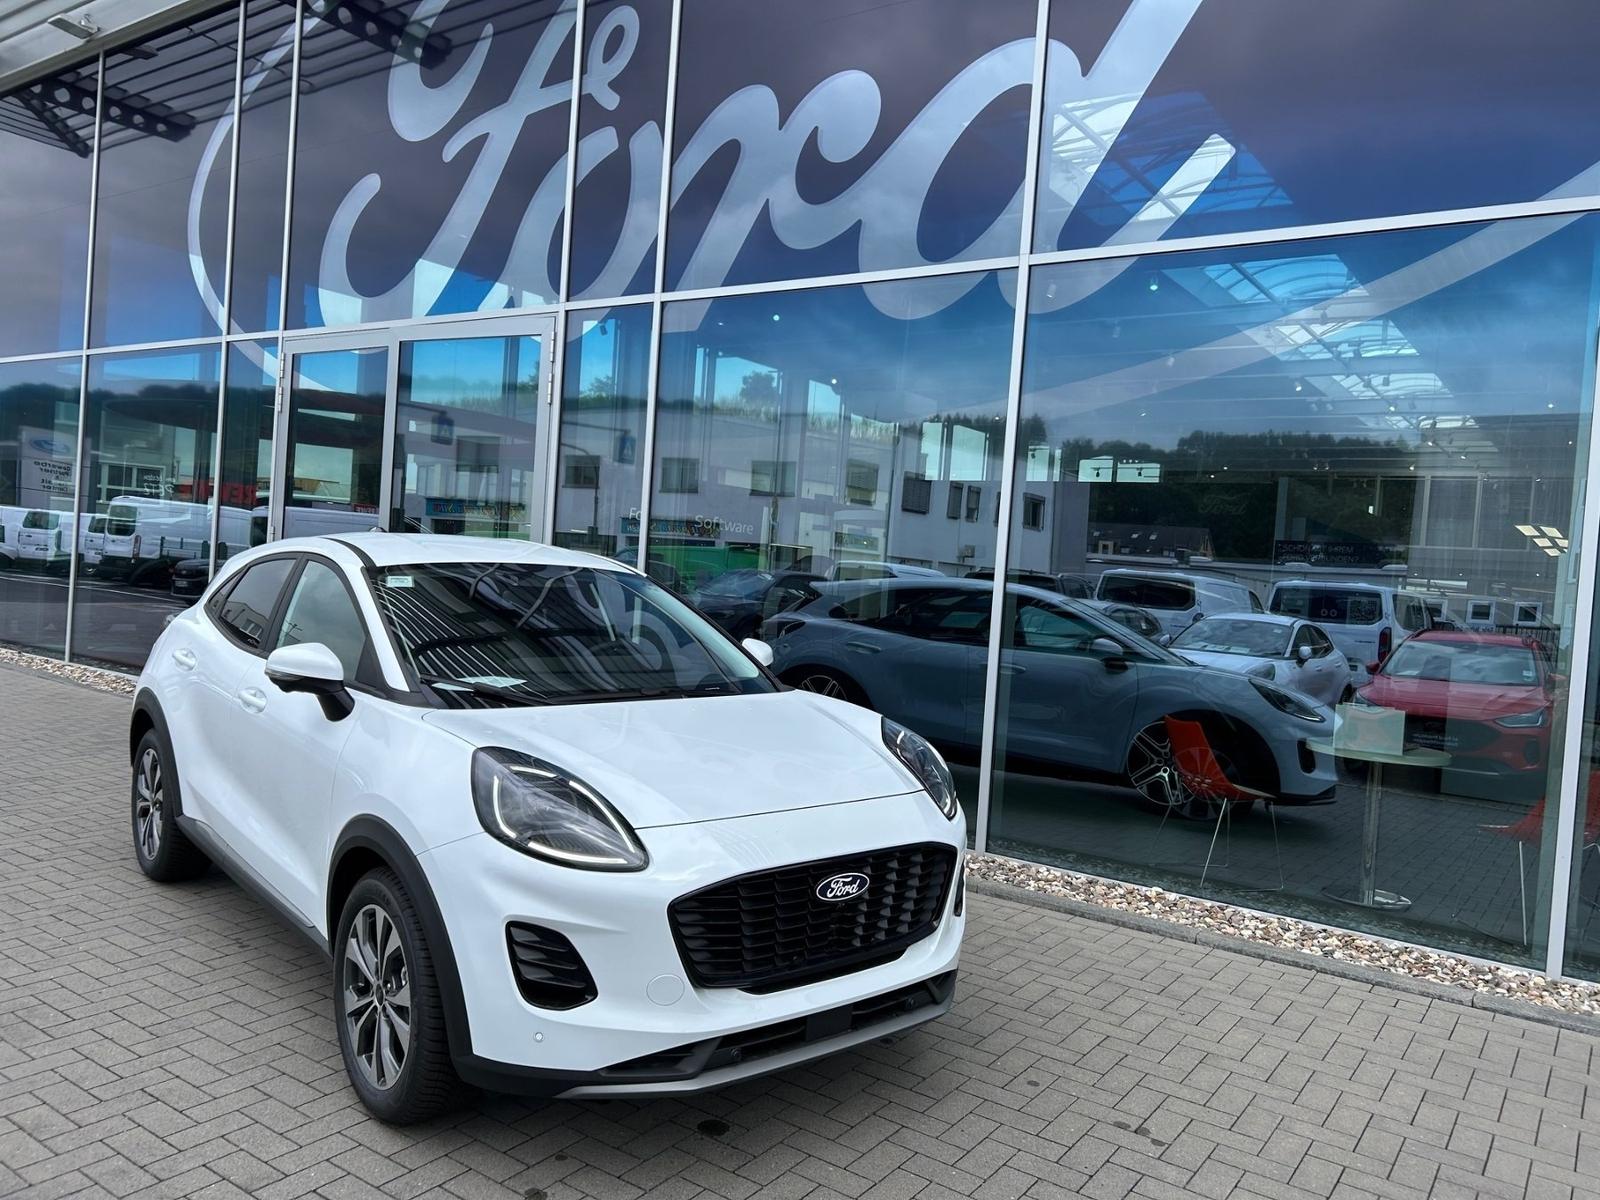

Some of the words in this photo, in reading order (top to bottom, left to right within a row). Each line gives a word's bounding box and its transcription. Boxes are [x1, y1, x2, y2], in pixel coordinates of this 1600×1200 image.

[318, 0, 1236, 342] Ford
[694, 514, 754, 536] Software
[826, 876, 861, 898] Ford
